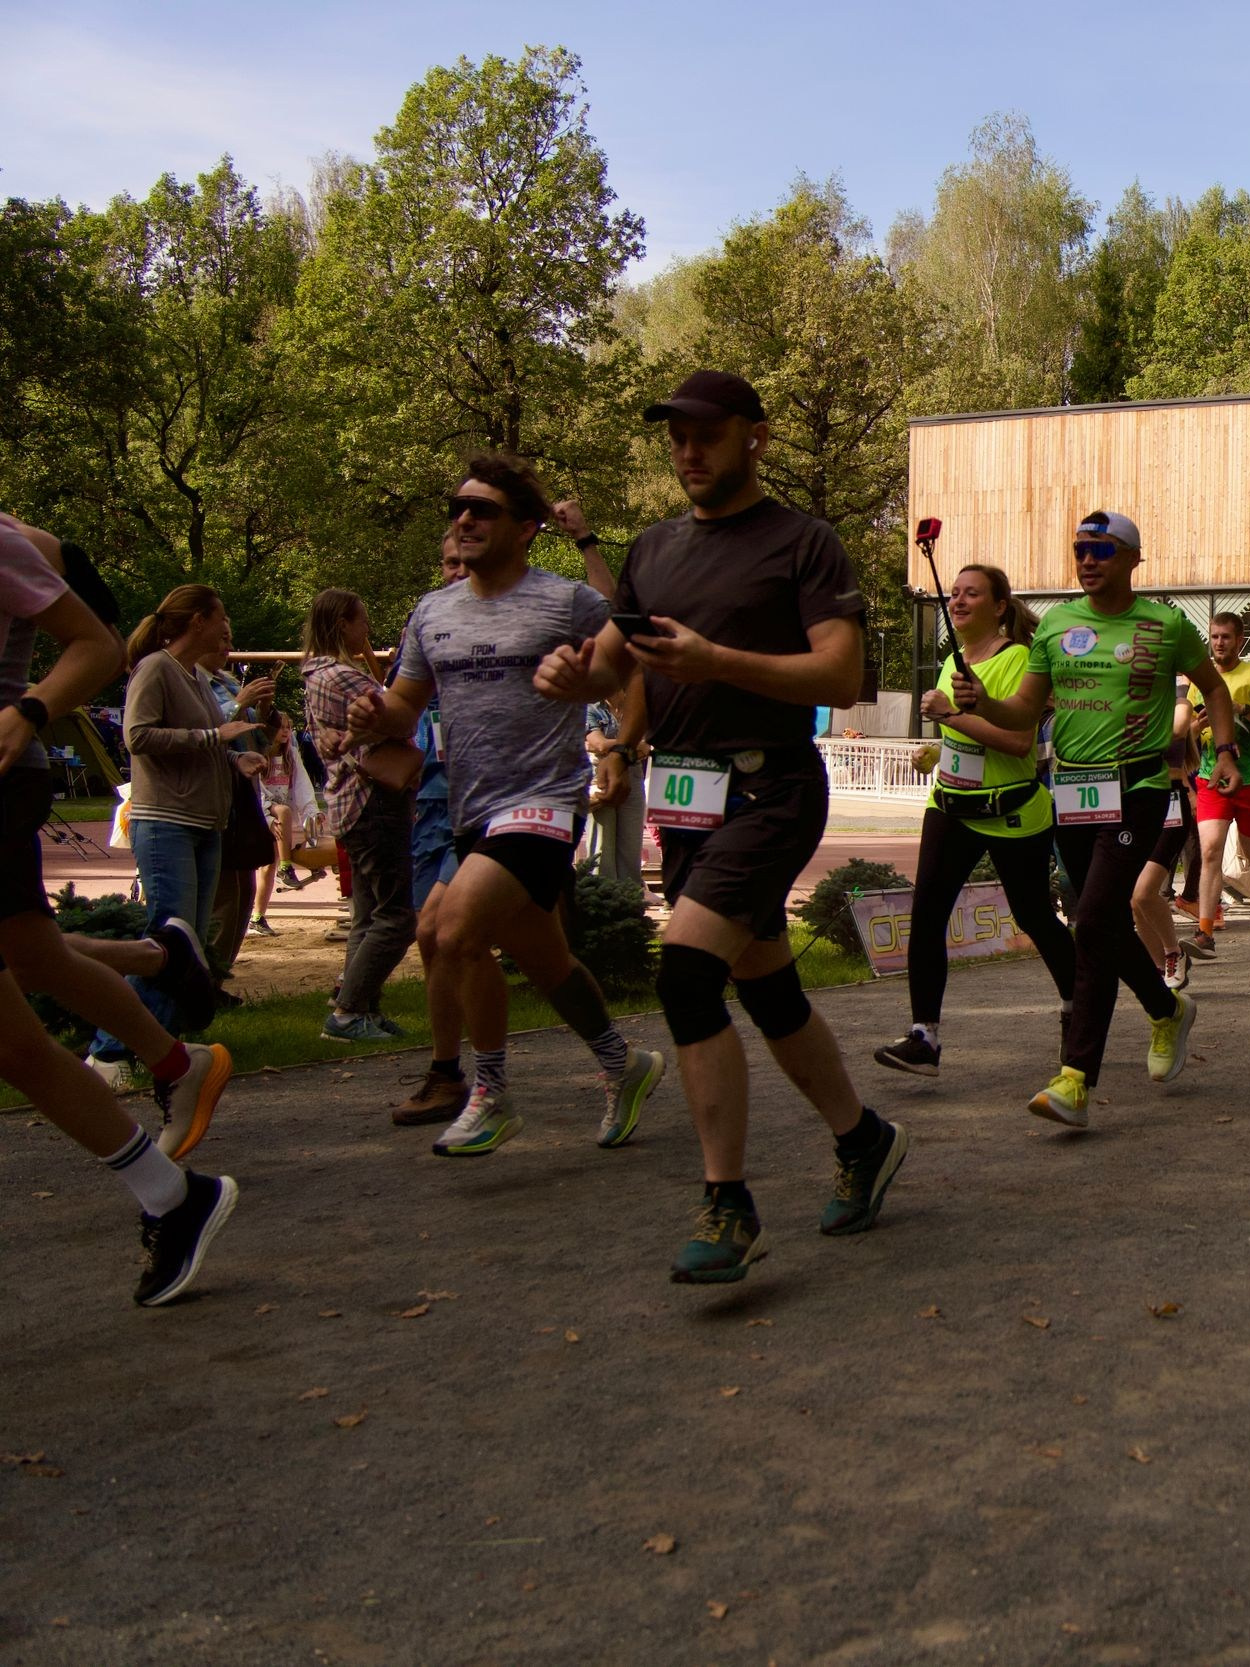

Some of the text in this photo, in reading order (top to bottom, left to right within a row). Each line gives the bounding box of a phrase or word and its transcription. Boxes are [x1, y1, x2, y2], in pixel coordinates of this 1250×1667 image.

[471, 644, 496, 656] ГРОМ
[1074, 661, 1112, 669] СПОРТА
[1056, 699, 1112, 712] оминск
[952, 754, 960, 774] 3
[1061, 772, 1113, 783] КРОСС ДУБКИ
[664, 774, 694, 806] 40
[1077, 786, 1099, 809] 70
